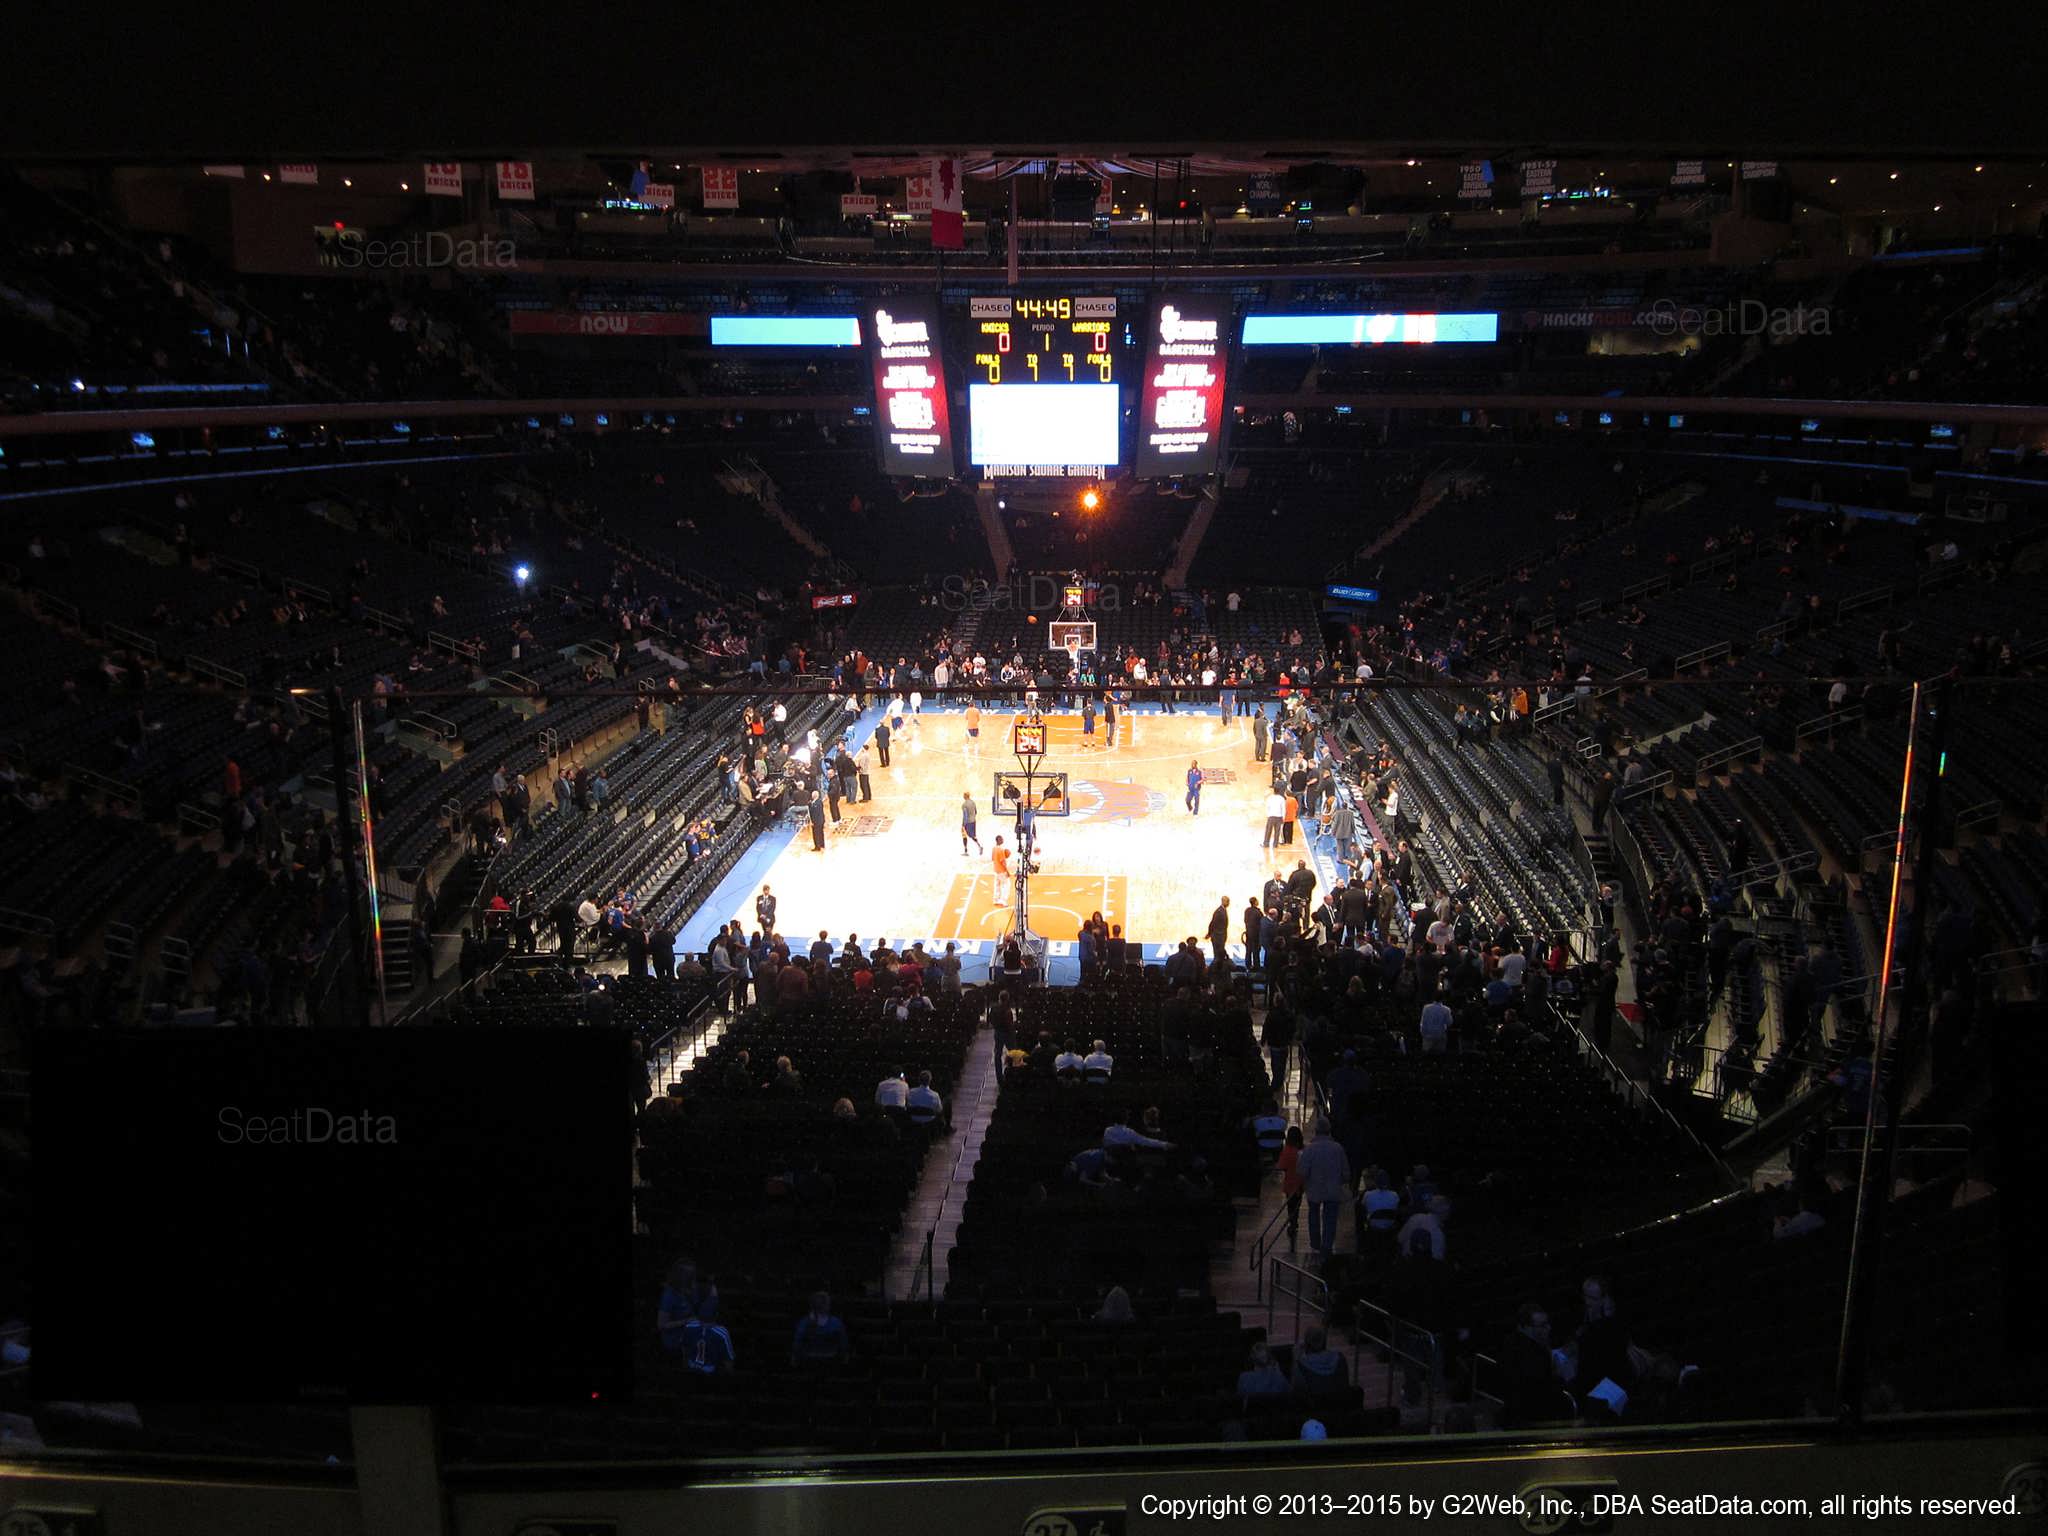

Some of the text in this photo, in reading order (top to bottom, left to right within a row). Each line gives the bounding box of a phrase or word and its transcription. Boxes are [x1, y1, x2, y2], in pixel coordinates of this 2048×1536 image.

[971, 304, 1002, 312] CHASE
[1016, 299, 1071, 320] 44:49
[1076, 303, 1107, 312] CHASE
[981, 322, 1010, 334] KNICKS
[1032, 324, 1055, 332] PERIOD
[1072, 322, 1111, 333] WARRIORS
[999, 332, 1010, 352] 0
[1095, 332, 1107, 352] 0
[976, 354, 1000, 365] FOULS
[1087, 354, 1112, 365] FOULS
[989, 363, 1000, 383] 0
[1100, 363, 1112, 383] 0
[984, 464, 1105, 480] MADISON SQUARE GARDEN
